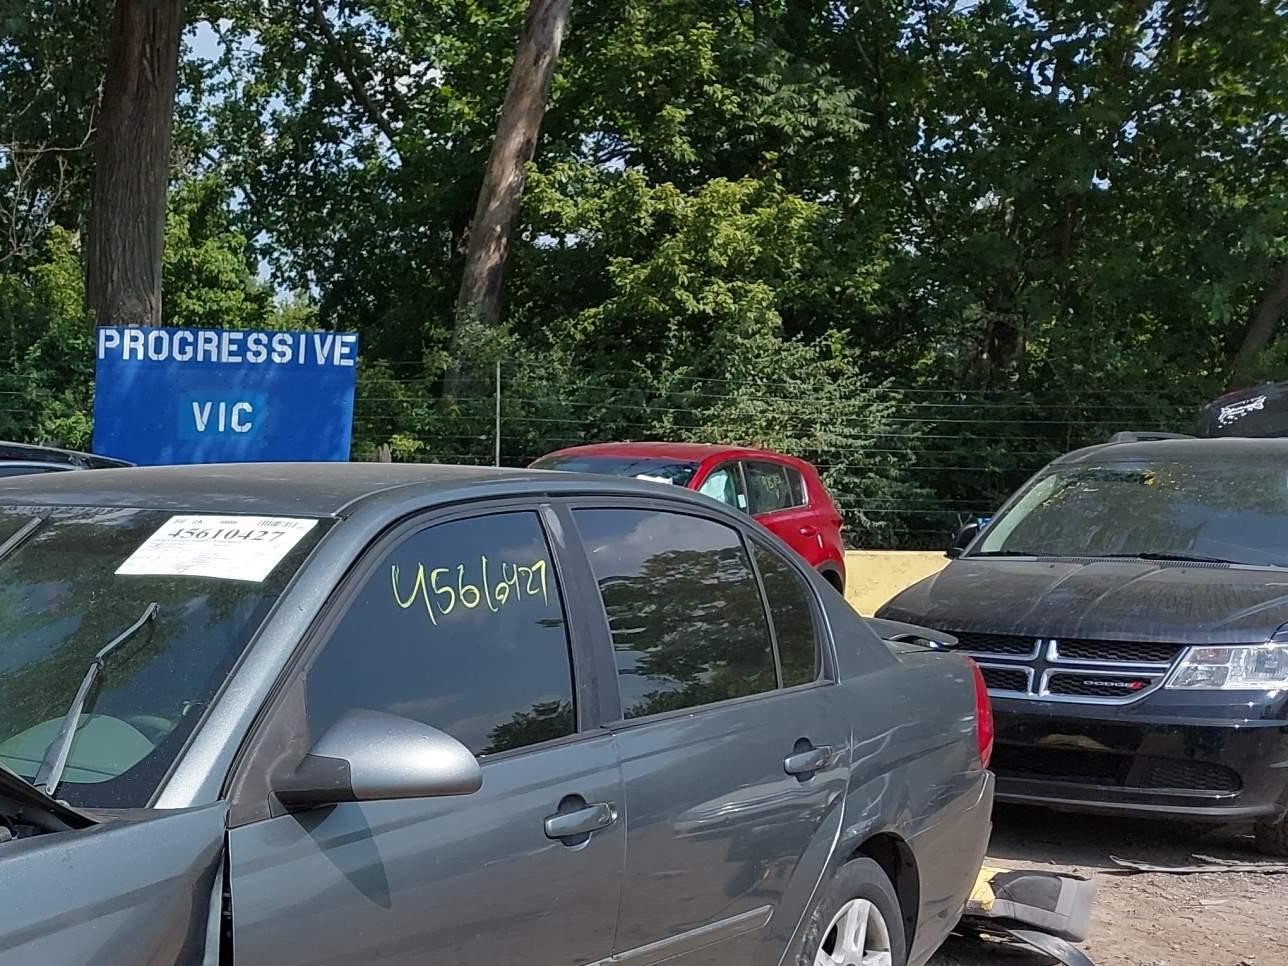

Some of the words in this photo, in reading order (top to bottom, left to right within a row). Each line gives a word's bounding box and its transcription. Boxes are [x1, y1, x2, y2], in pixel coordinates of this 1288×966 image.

[98, 328, 357, 366] PROGRESSIVE
[191, 401, 254, 433] VIC
[167, 527, 288, 543] 45610427
